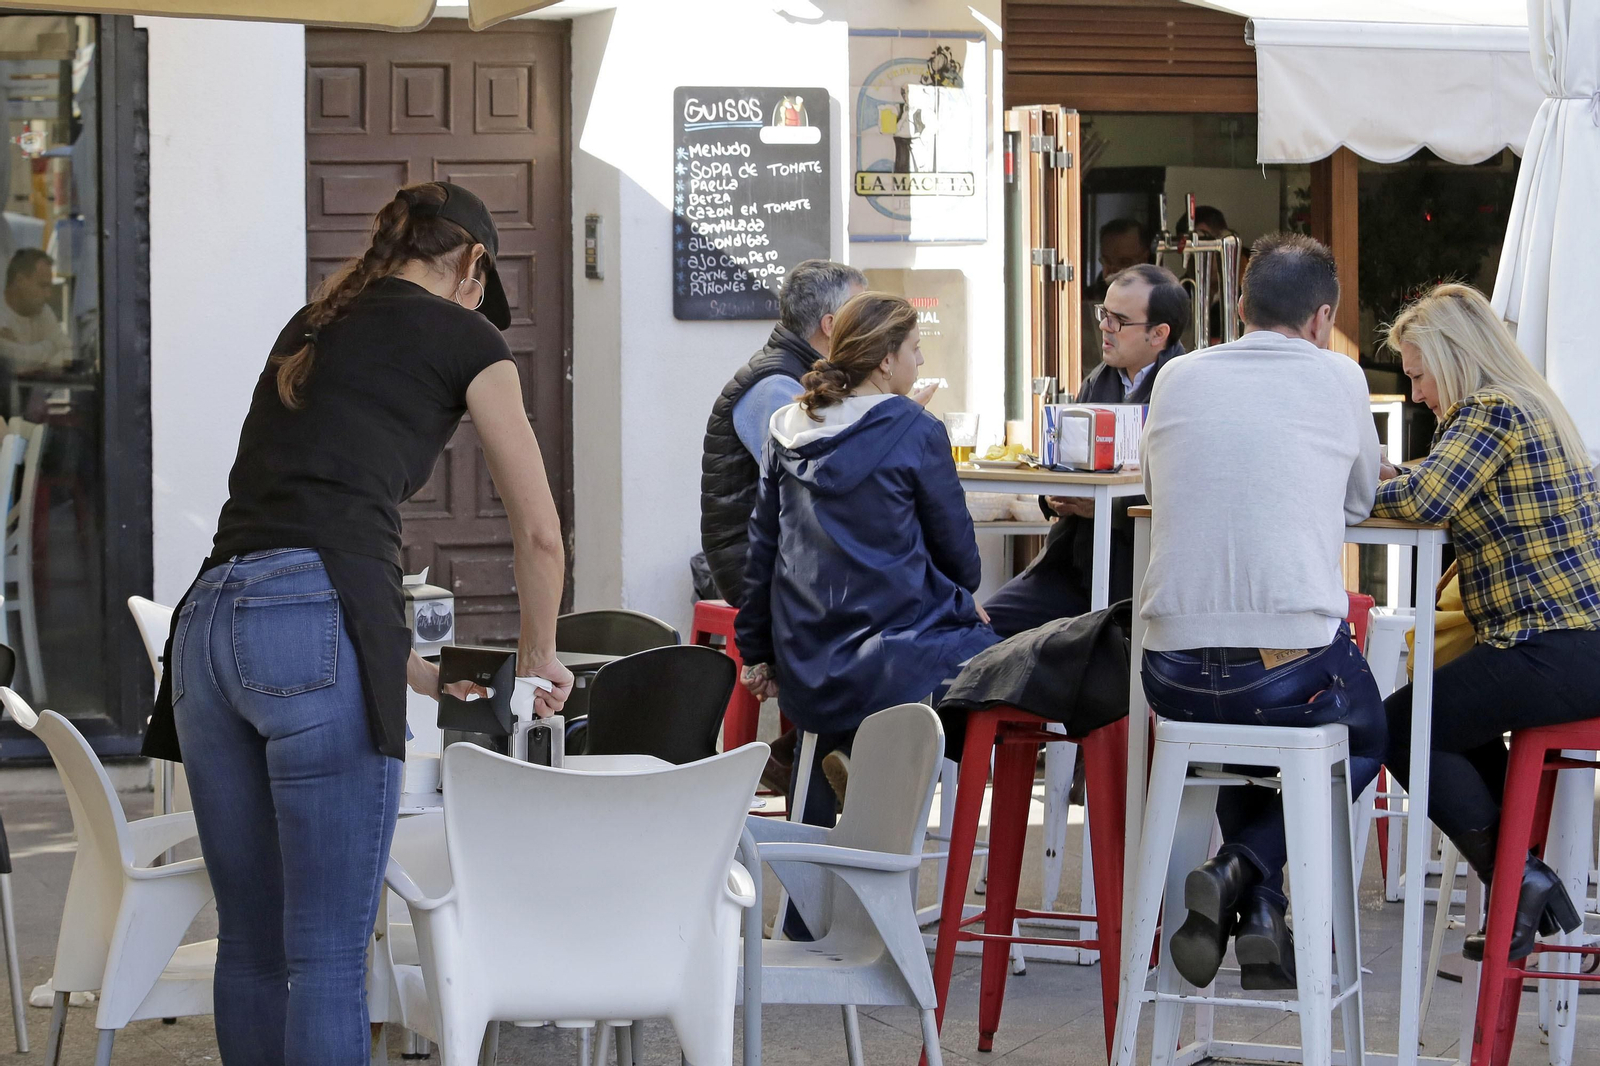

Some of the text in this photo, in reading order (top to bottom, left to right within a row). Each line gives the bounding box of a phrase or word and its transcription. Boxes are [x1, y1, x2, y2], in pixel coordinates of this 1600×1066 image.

[684, 98, 763, 122] GUISOS
[766, 160, 822, 176] TOMATE
[860, 176, 971, 191] LA MACETA
